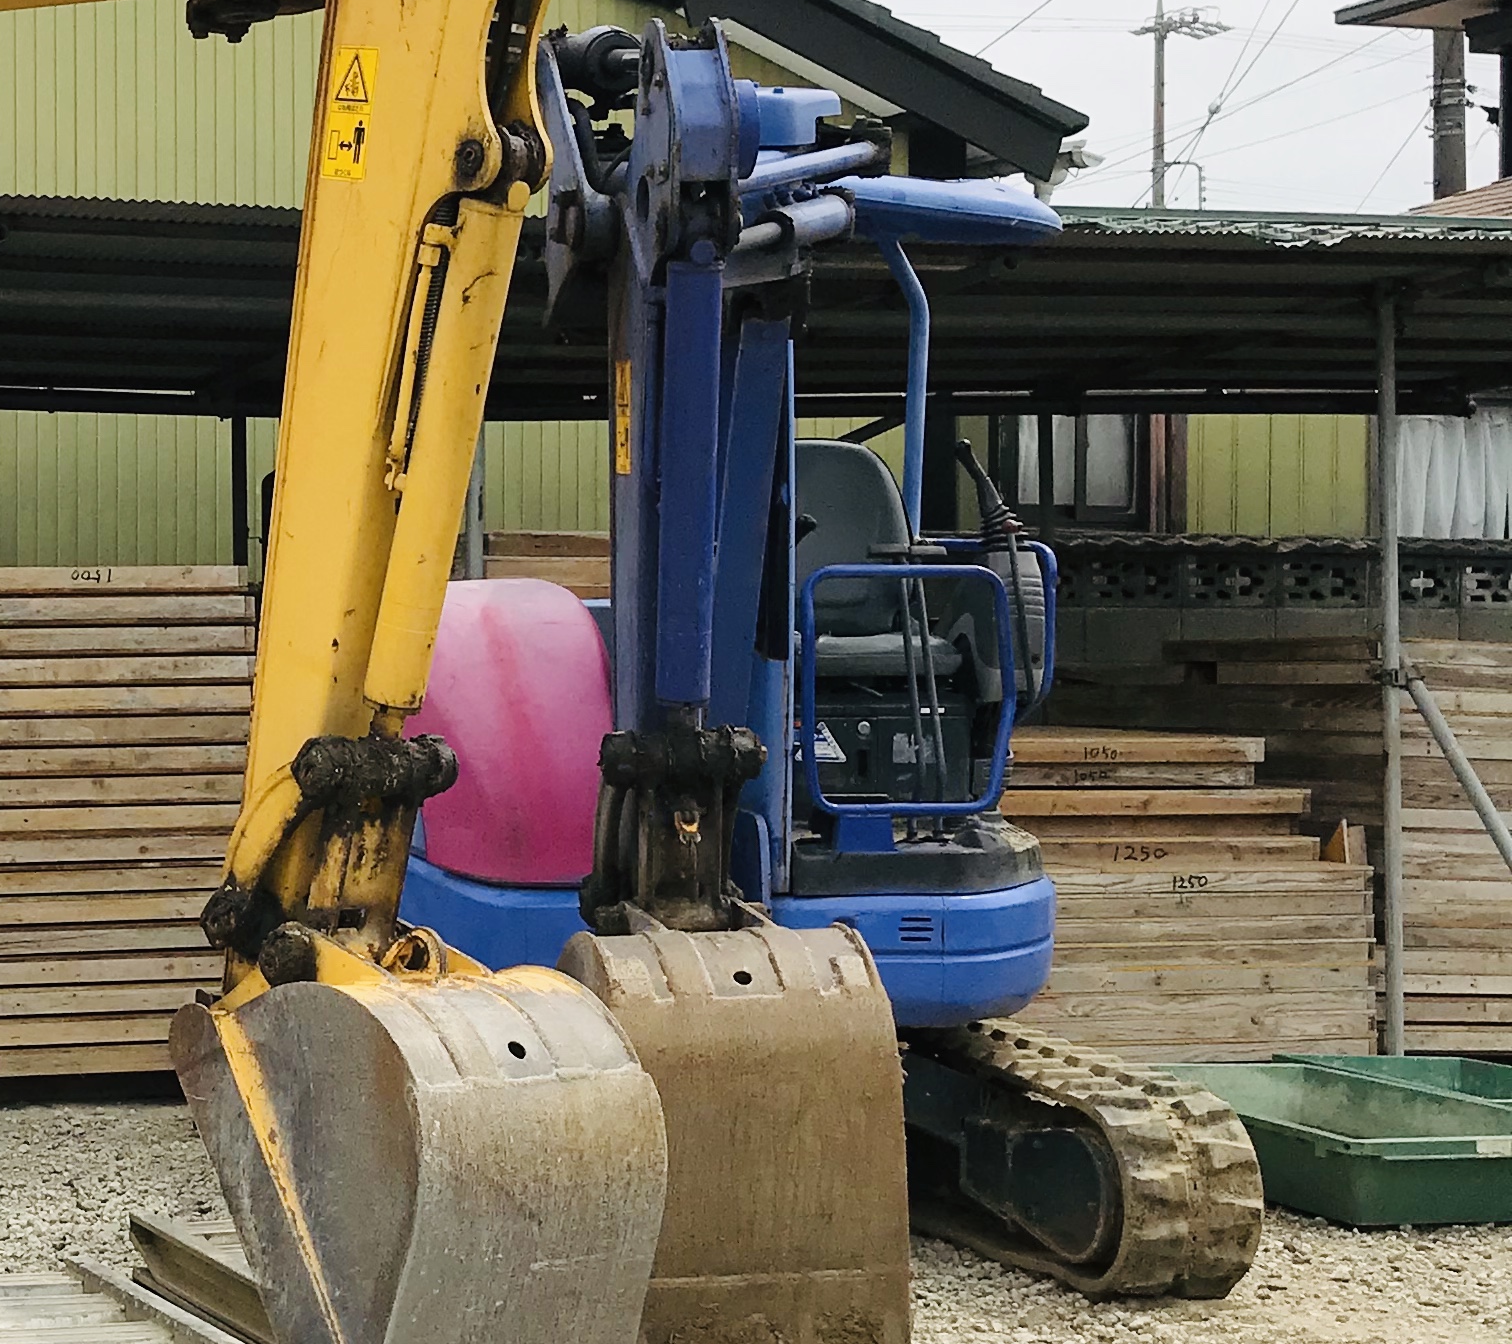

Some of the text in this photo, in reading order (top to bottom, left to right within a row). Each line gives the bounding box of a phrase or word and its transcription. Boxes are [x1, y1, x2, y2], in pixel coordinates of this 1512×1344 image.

[1084, 745, 1118, 760] 1050
[1113, 845, 1168, 862] 1250
[1173, 874, 1208, 891] 1250
